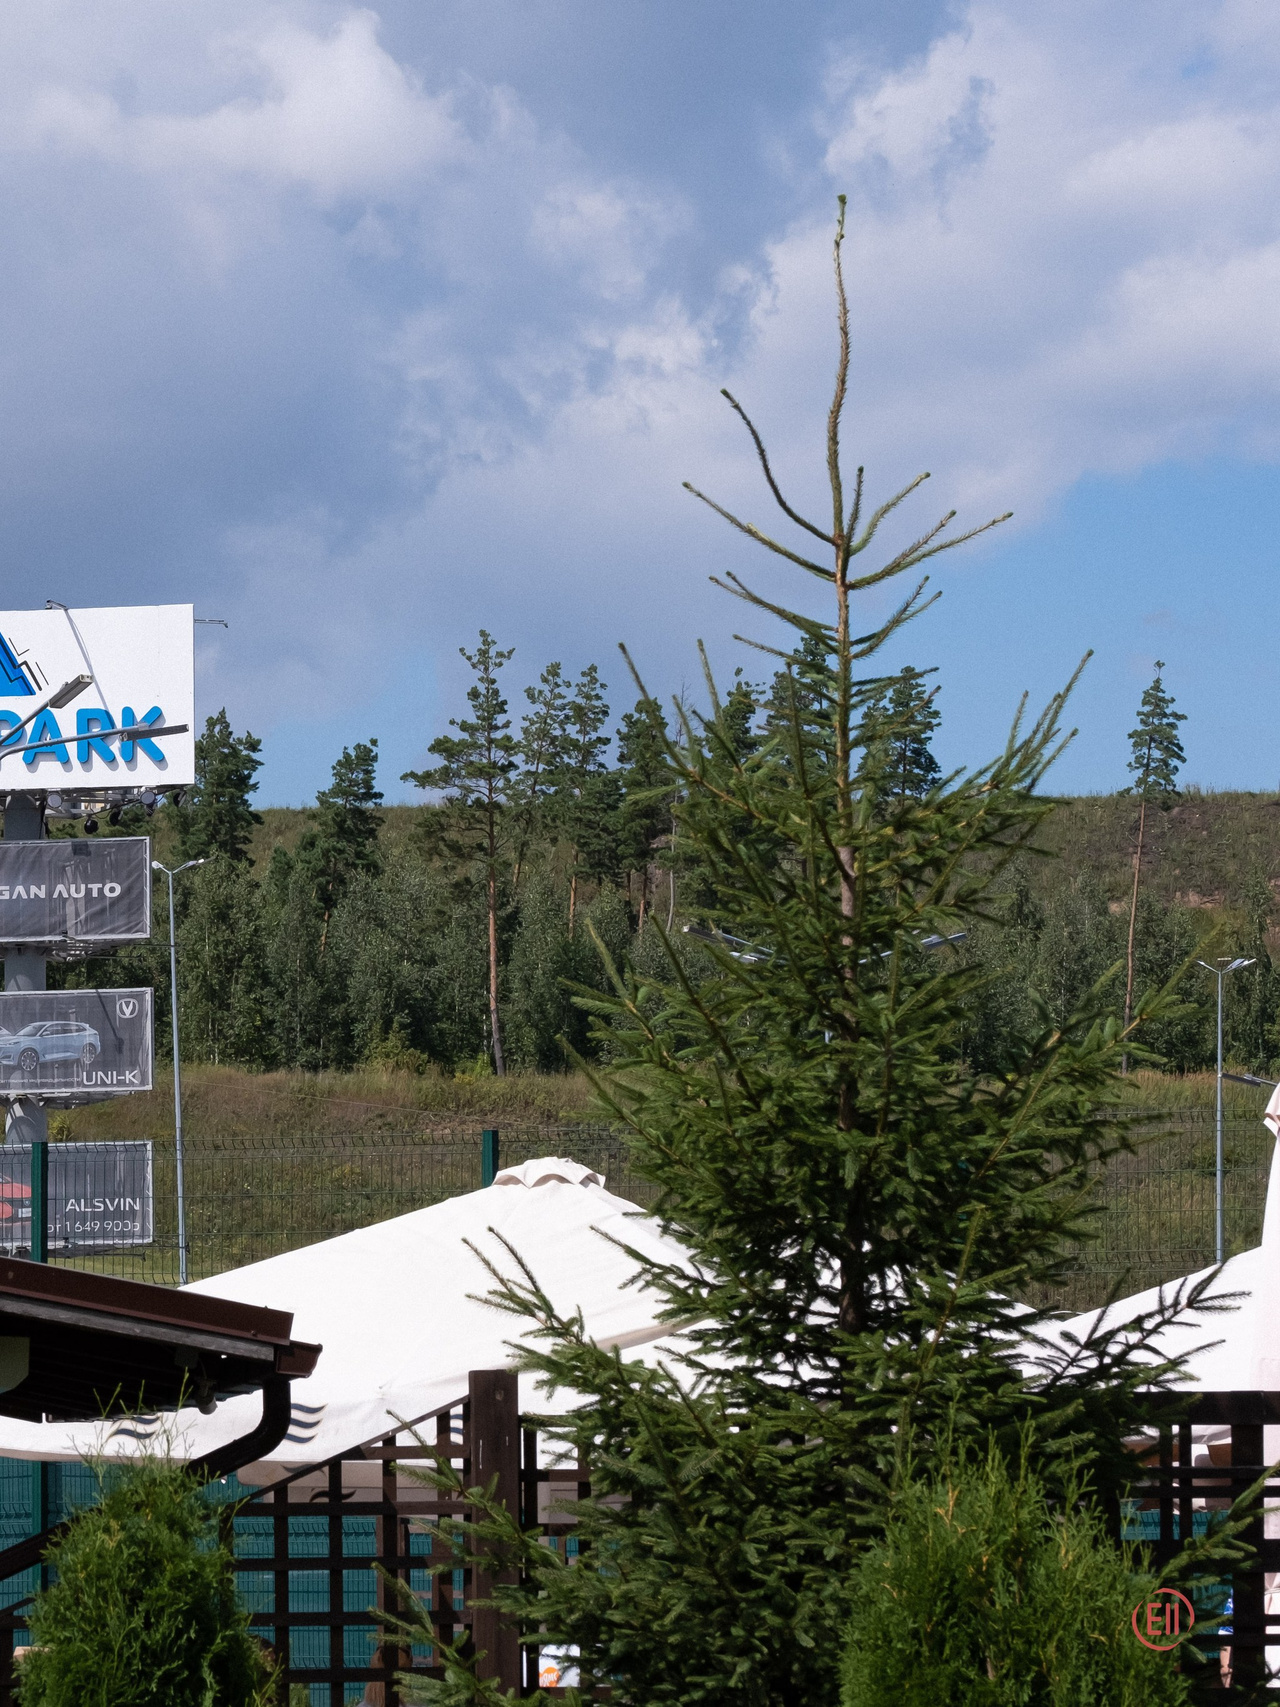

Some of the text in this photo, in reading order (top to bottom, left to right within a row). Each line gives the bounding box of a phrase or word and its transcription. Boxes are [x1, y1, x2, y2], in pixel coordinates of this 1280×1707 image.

[53, 882, 121, 899] AUTO
[83, 1070, 139, 1085] UNI-K
[65, 1197, 140, 1212] ALSVIN
